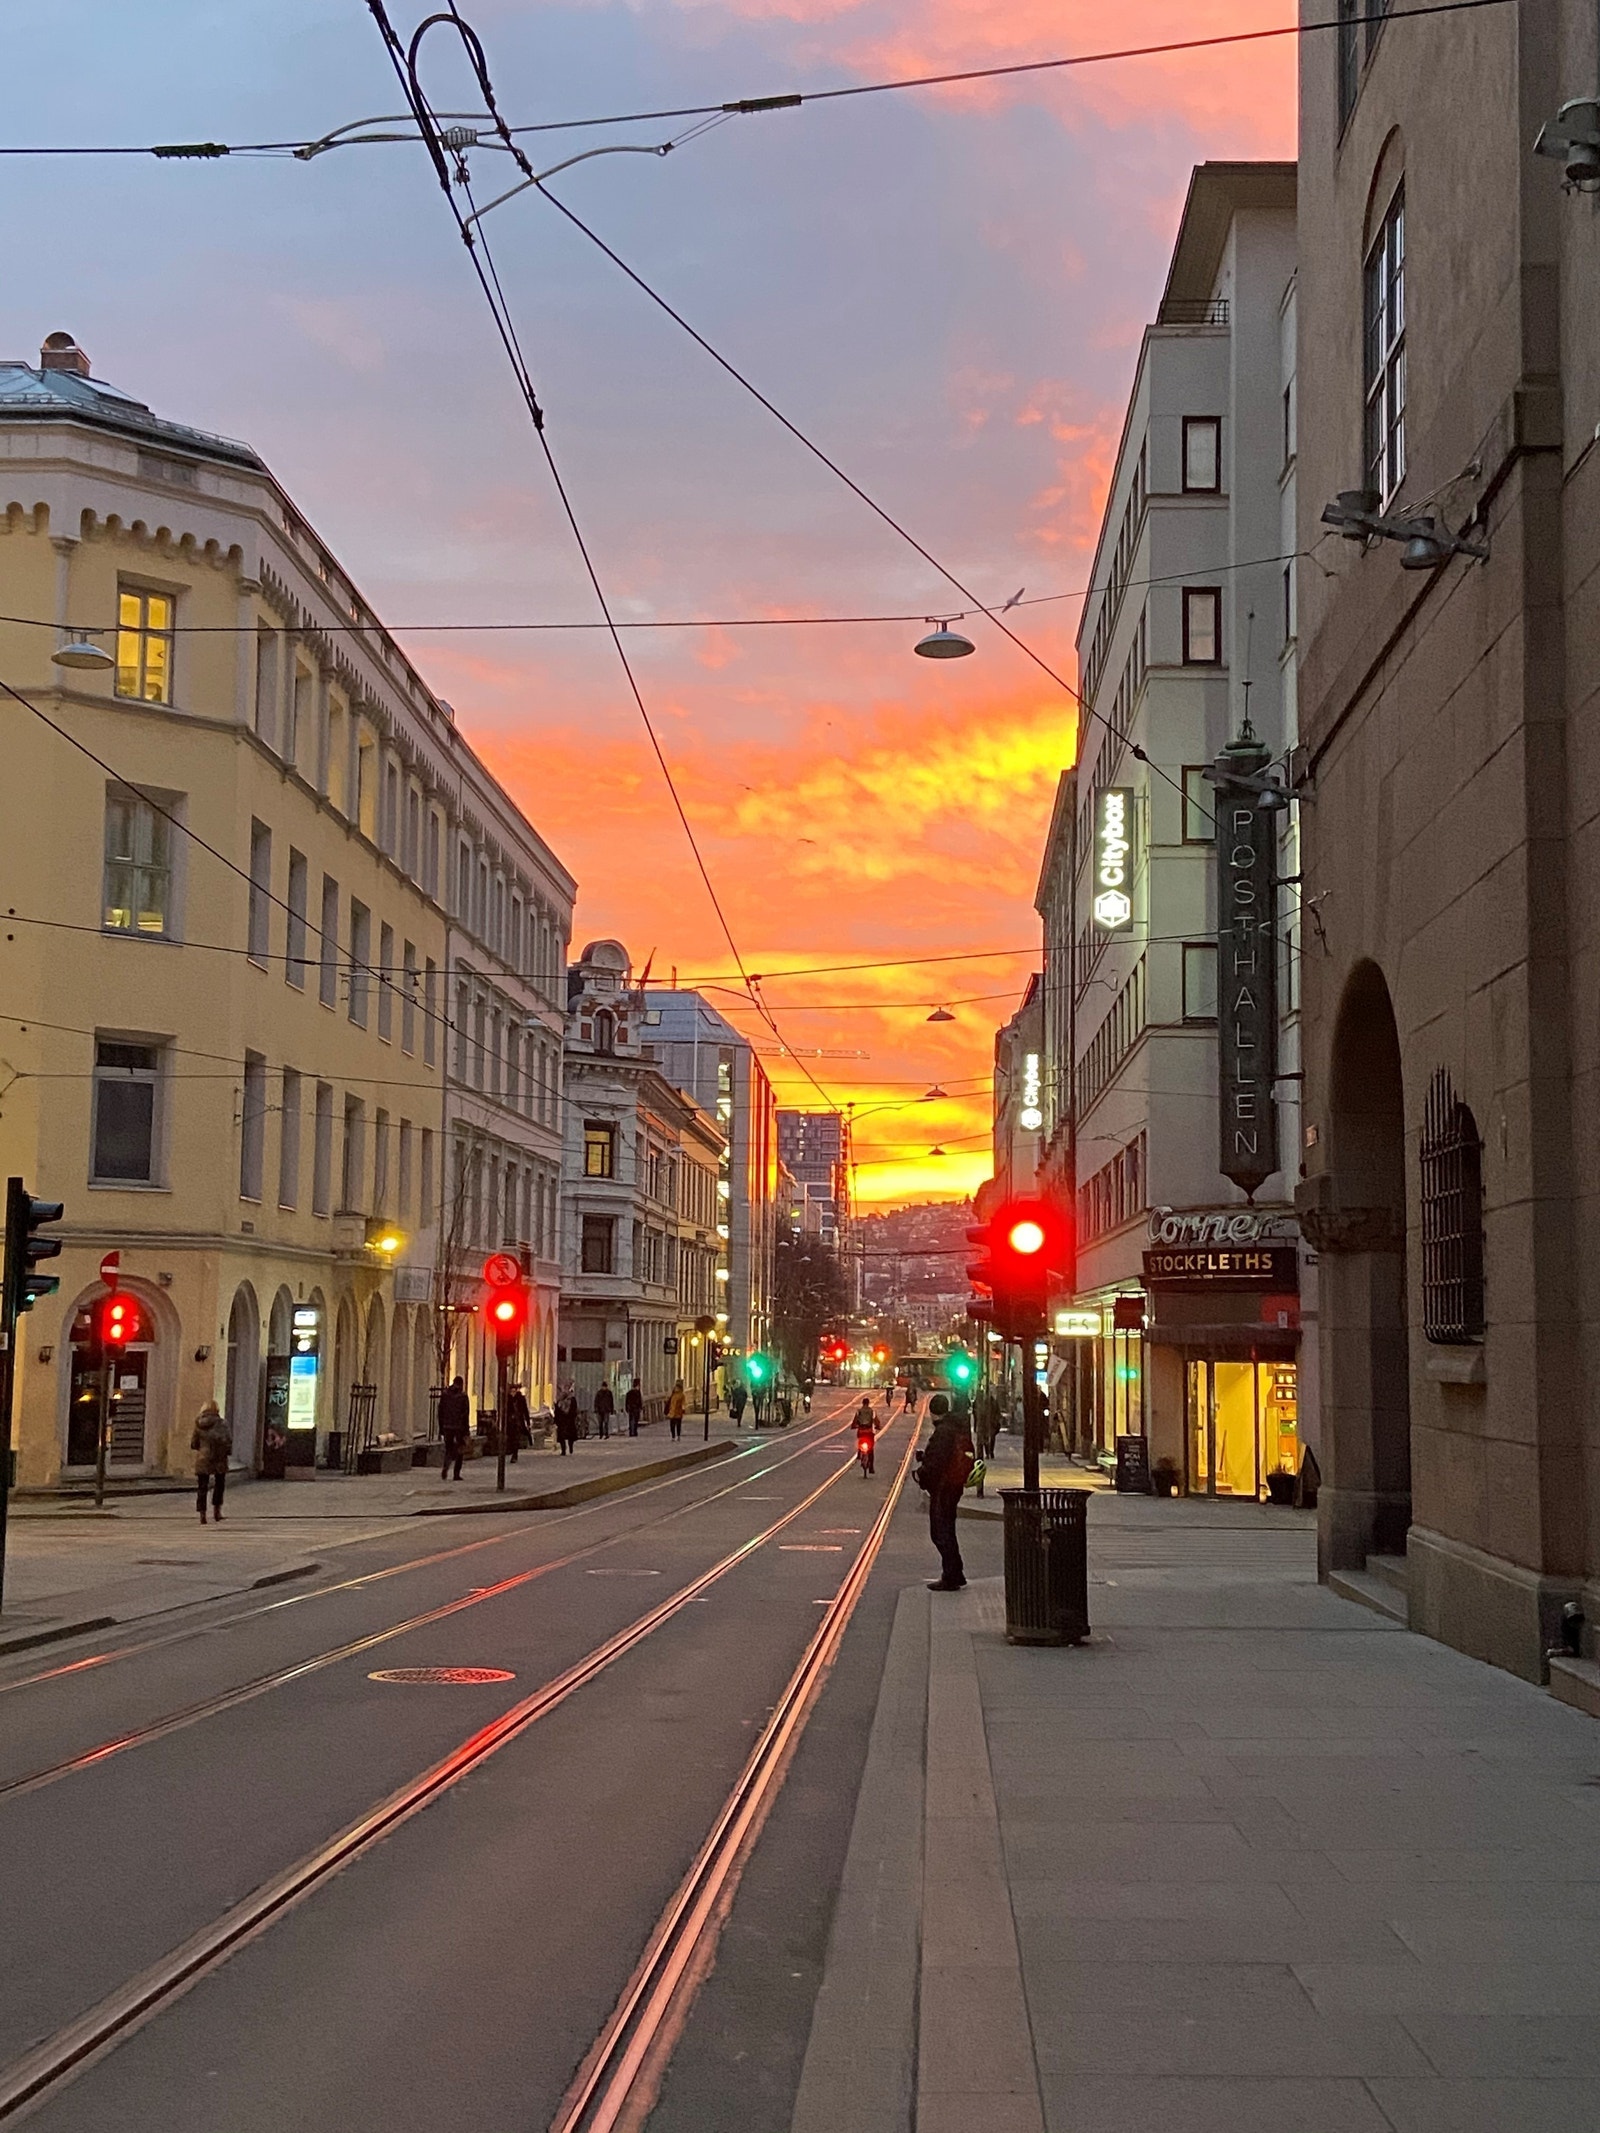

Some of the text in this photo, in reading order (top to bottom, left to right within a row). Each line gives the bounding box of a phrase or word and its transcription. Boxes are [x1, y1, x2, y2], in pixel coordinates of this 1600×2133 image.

[1100, 793, 1129, 887] Citybox
[1230, 809, 1258, 1155] POSTHALLEN
[1147, 1206, 1285, 1244] Corner
[1150, 1253, 1273, 1272] STOCKFLETHS
